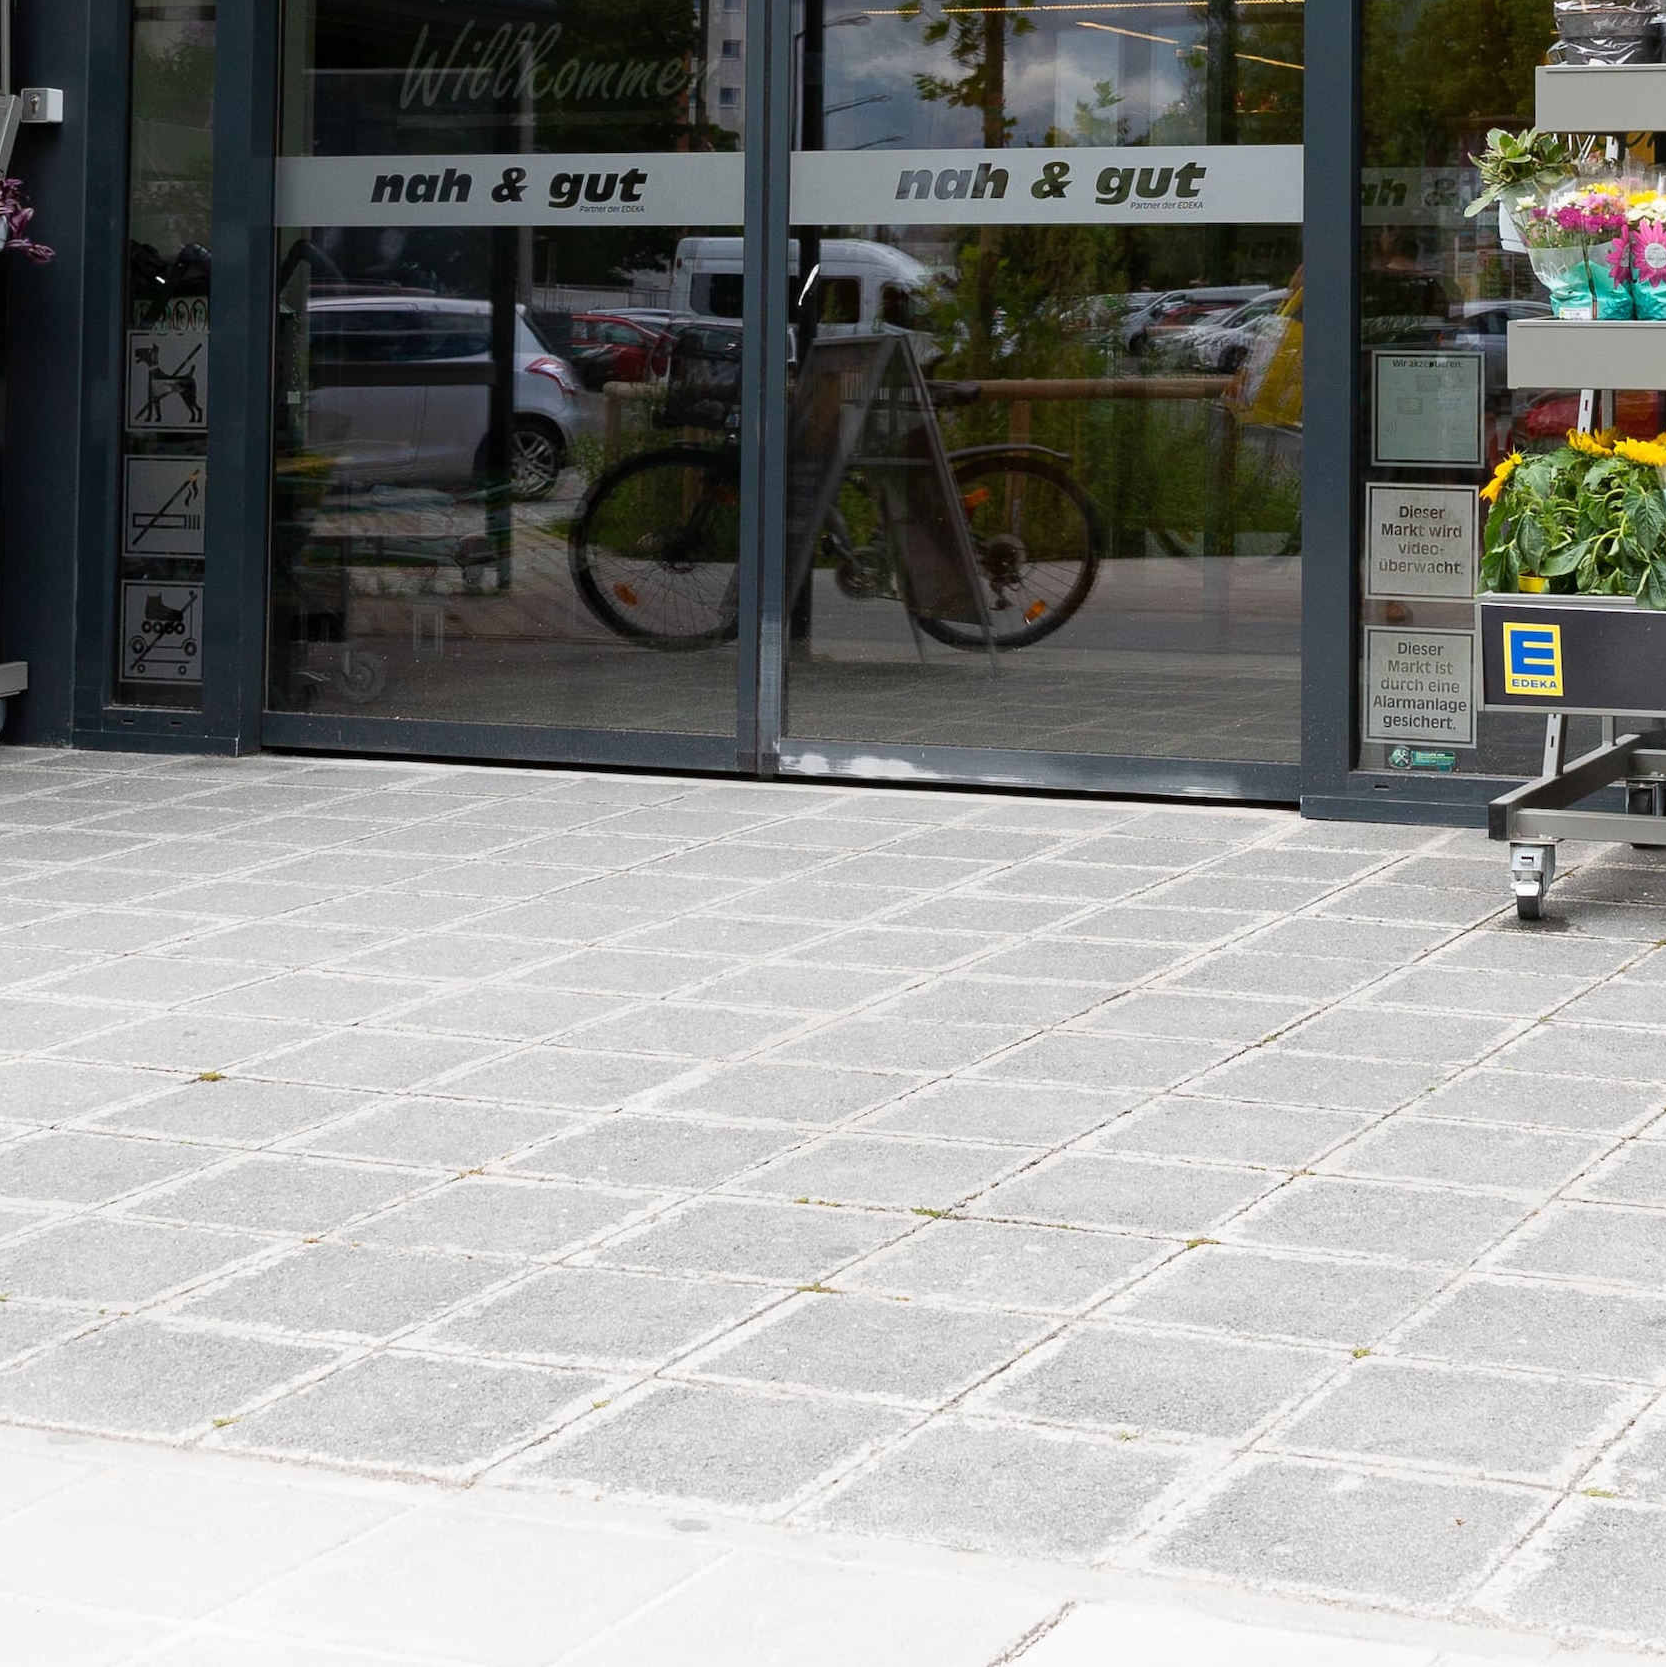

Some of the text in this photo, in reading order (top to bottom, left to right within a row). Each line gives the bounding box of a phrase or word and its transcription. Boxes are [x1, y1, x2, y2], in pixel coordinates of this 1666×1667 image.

[399, 19, 720, 111] Willkommen
[370, 167, 648, 209] nah & gut
[894, 161, 1207, 205] nah & gut
[579, 204, 645, 213] Partner der EDEKA
[1130, 200, 1204, 211] Partner der EDEKA
[1393, 360, 1407, 368] Wir
[1399, 505, 1445, 519] Dieser
[1381, 522, 1462, 538] Markt wird
[1398, 541, 1445, 556] video-
[1379, 559, 1464, 576] überwacht.
[1397, 641, 1444, 656] Dieser
[1387, 659, 1453, 674] Markt ist
[1381, 677, 1460, 692] durch eine
[1511, 678, 1557, 690] EDEKA
[1373, 696, 1467, 715] Alarmanlage
[1383, 714, 1456, 732] gesichert.
